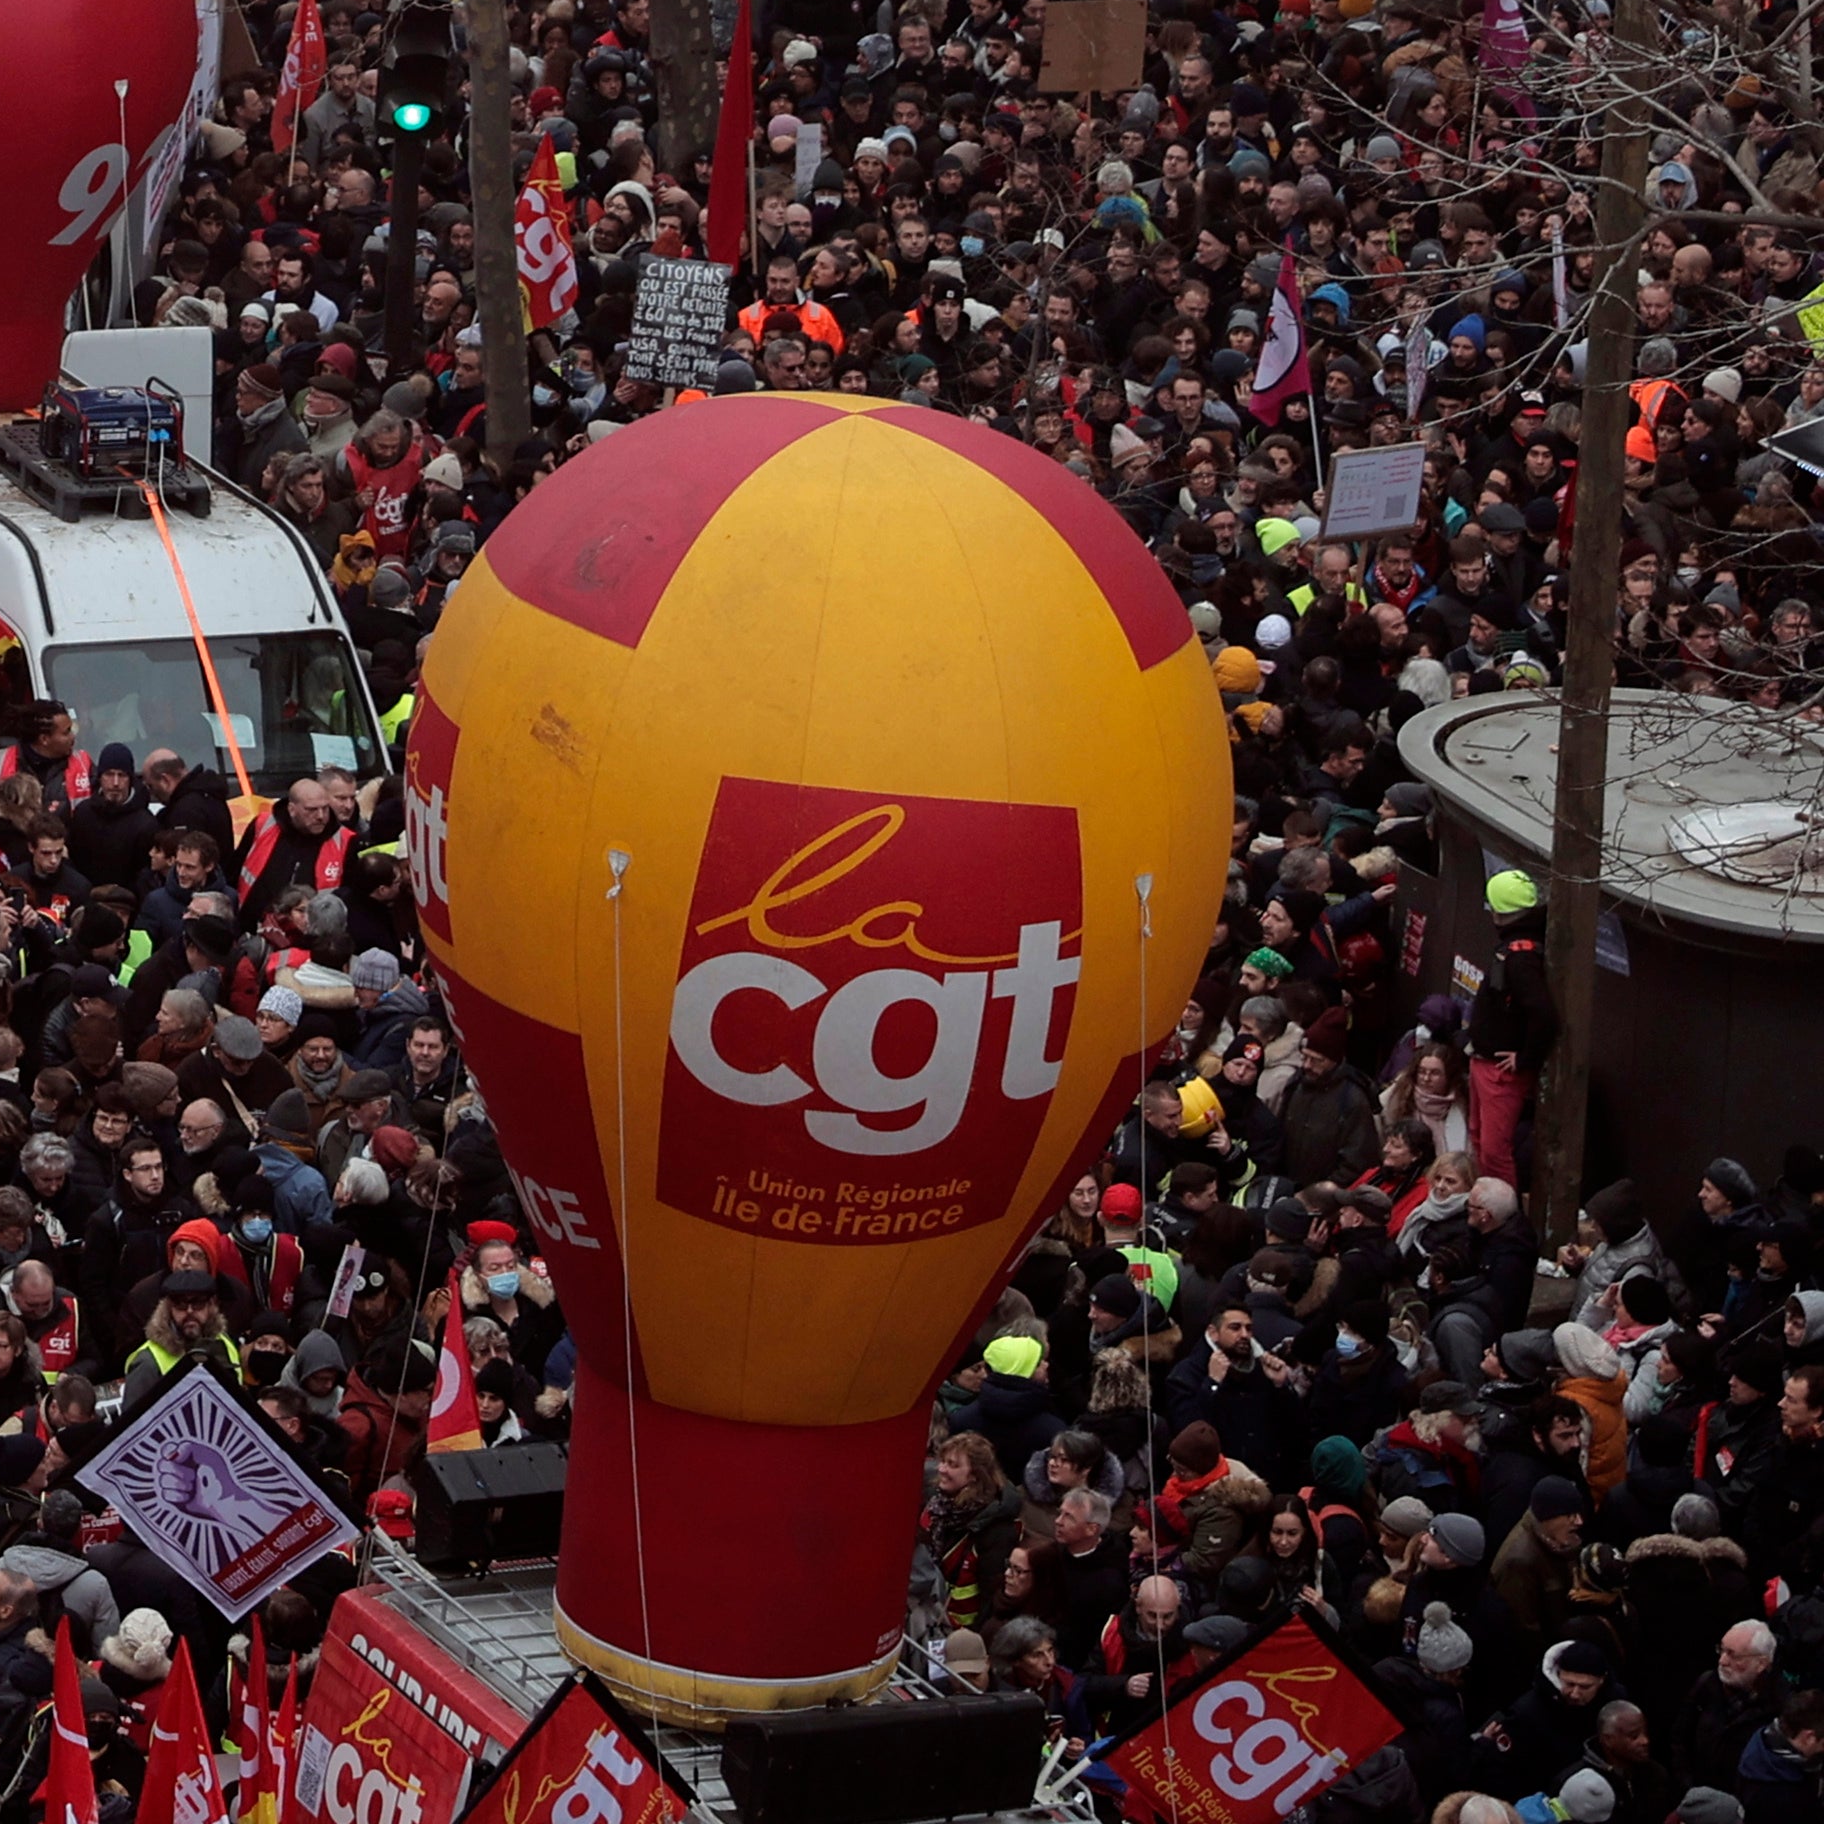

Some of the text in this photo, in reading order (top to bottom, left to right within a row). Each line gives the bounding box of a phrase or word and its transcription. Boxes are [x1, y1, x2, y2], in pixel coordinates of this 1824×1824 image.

[640, 277, 660, 291] OU
[662, 280, 687, 296] EST
[645, 258, 725, 285] CITOYENS
[637, 292, 679, 310] NOTRE
[644, 306, 665, 323] 60
[663, 325, 684, 341] LES
[659, 352, 691, 369] SERA
[694, 802, 1087, 965] la
[667, 918, 1084, 1157] cgt
[711, 1174, 762, 1224] Île
[747, 1169, 973, 1211] Union Régionale
[302, 1506, 326, 1534] cgt
[1244, 1664, 1351, 1771] la
[340, 1687, 425, 1797] la
[1190, 1678, 1350, 1819] cgt
[324, 1740, 423, 1824] cgt
[550, 1728, 643, 1824] gt
